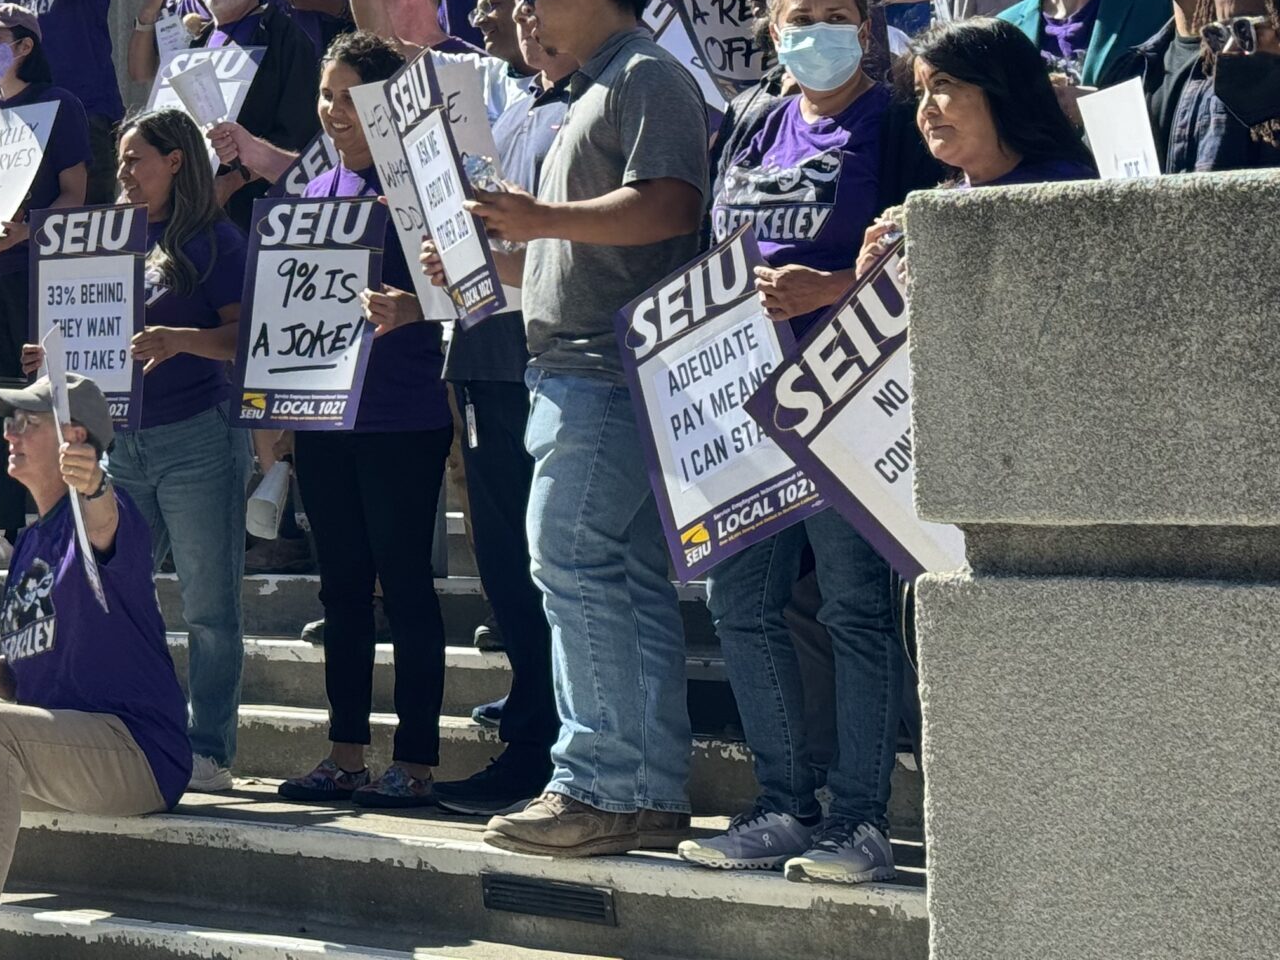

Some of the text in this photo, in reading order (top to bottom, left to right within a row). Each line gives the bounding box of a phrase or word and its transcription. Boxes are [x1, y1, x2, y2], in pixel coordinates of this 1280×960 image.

[390, 57, 432, 133] SEIU
[39, 208, 134, 256] SEIU
[261, 201, 372, 246] SEIU
[47, 282, 127, 306] 33% BEHIND,
[277, 257, 358, 308] 9% IS
[463, 278, 494, 309] LOCAL 1021
[633, 234, 749, 361] SEIU
[87, 316, 122, 338] WANT
[251, 316, 366, 362] A JOKE!
[775, 253, 909, 438] SEIU
[65, 348, 127, 372] TO TAKE 9
[668, 322, 760, 397] ADEQUATE
[239, 409, 265, 420] SEIU
[272, 400, 347, 415] LOCAL 1021
[872, 377, 910, 418] NO
[670, 398, 705, 442] PAY
[680, 435, 729, 483] I CAN
[717, 498, 774, 540] LOCAL
[686, 541, 712, 568] SEIU
